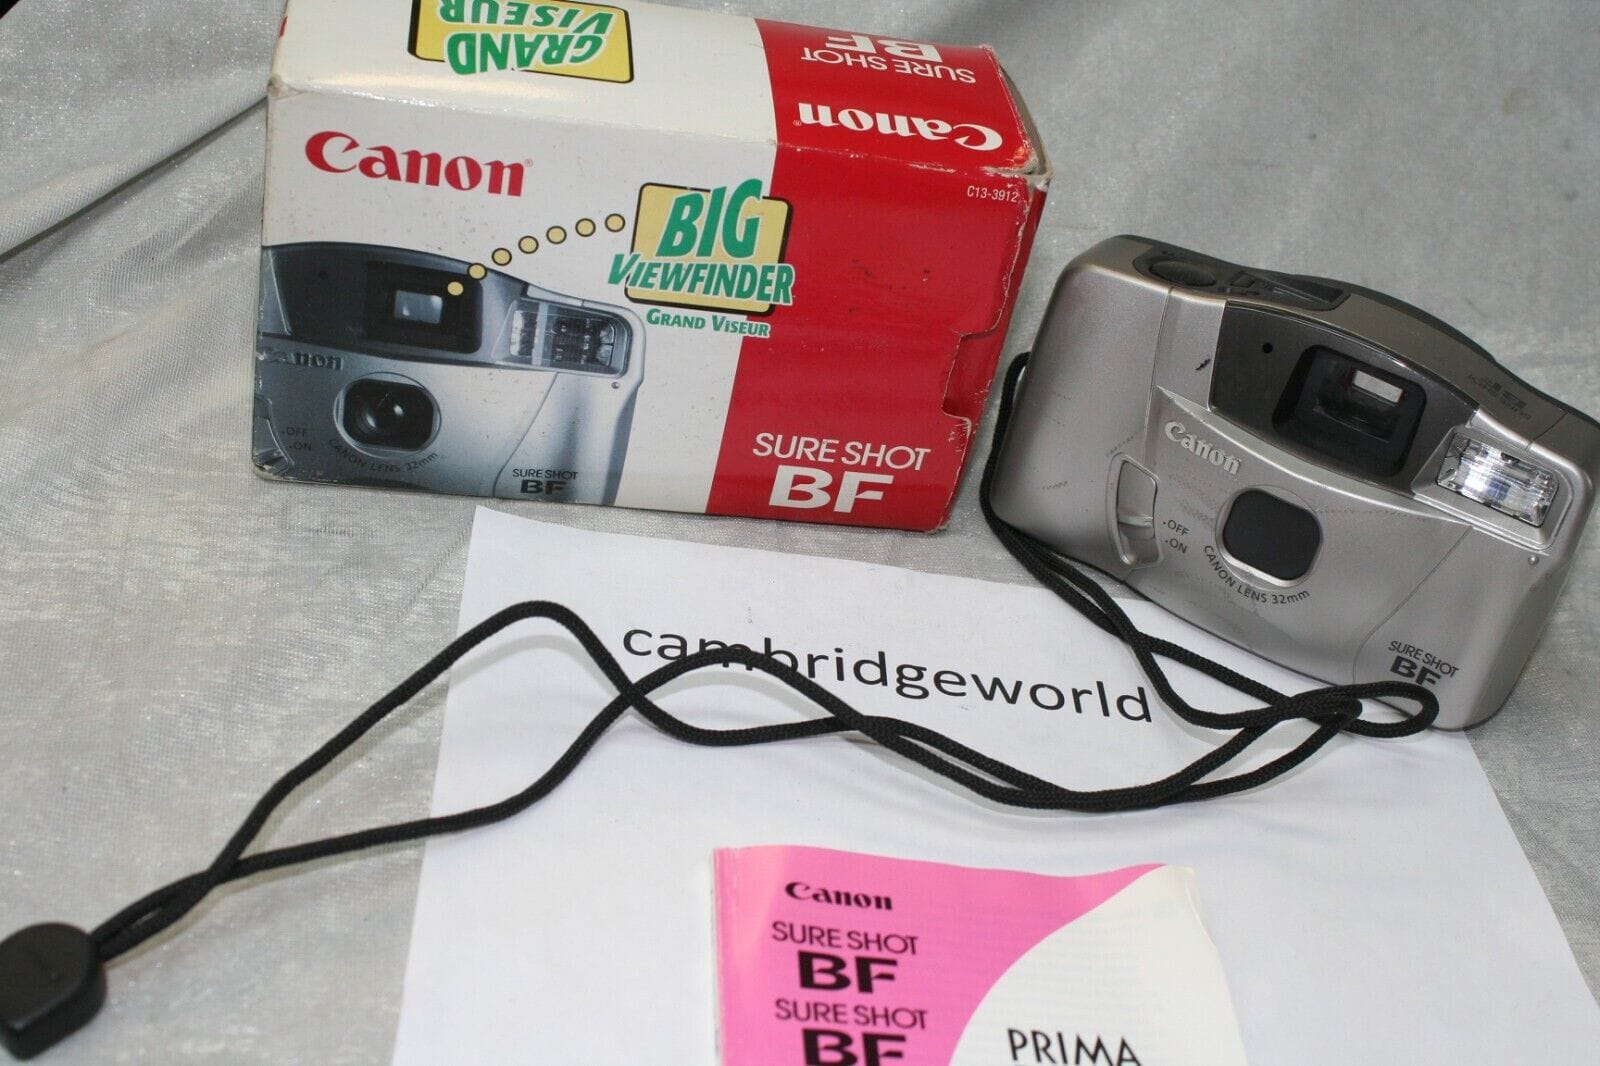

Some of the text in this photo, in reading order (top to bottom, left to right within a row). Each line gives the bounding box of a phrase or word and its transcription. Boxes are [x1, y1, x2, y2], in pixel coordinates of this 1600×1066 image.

[439, 0, 614, 35] VISEUR
[447, 33, 603, 75] GRAND
[801, 47, 976, 84] SURE SHOT
[825, 34, 943, 62] BF
[799, 102, 1003, 151] Canon
[305, 131, 525, 197] Canon
[967, 185, 1018, 202] C13-3912
[656, 178, 763, 259] BIG
[607, 253, 794, 304] VIEWFINDER
[646, 308, 770, 337] GRAND VISEUR
[753, 432, 932, 471] SURE SHOT
[1164, 421, 1242, 475] Canon
[512, 468, 579, 481] SURE SHOT
[520, 479, 567, 495] BF
[768, 464, 895, 514] BF
[1167, 519, 1190, 537] OFF
[1169, 538, 1188, 554] ON
[1203, 545, 1311, 605] CANON LENS 32mm
[1387, 640, 1460, 678] SURE SHOT
[1389, 655, 1442, 686] BF
[785, 881, 893, 911] Canon
[772, 920, 918, 956] SURE SHOT
[798, 949, 898, 994] BF
[775, 998, 927, 1030] SURE SHOT
[802, 1028, 907, 1066] BF
[1007, 1027, 1142, 1066] PRIMA
